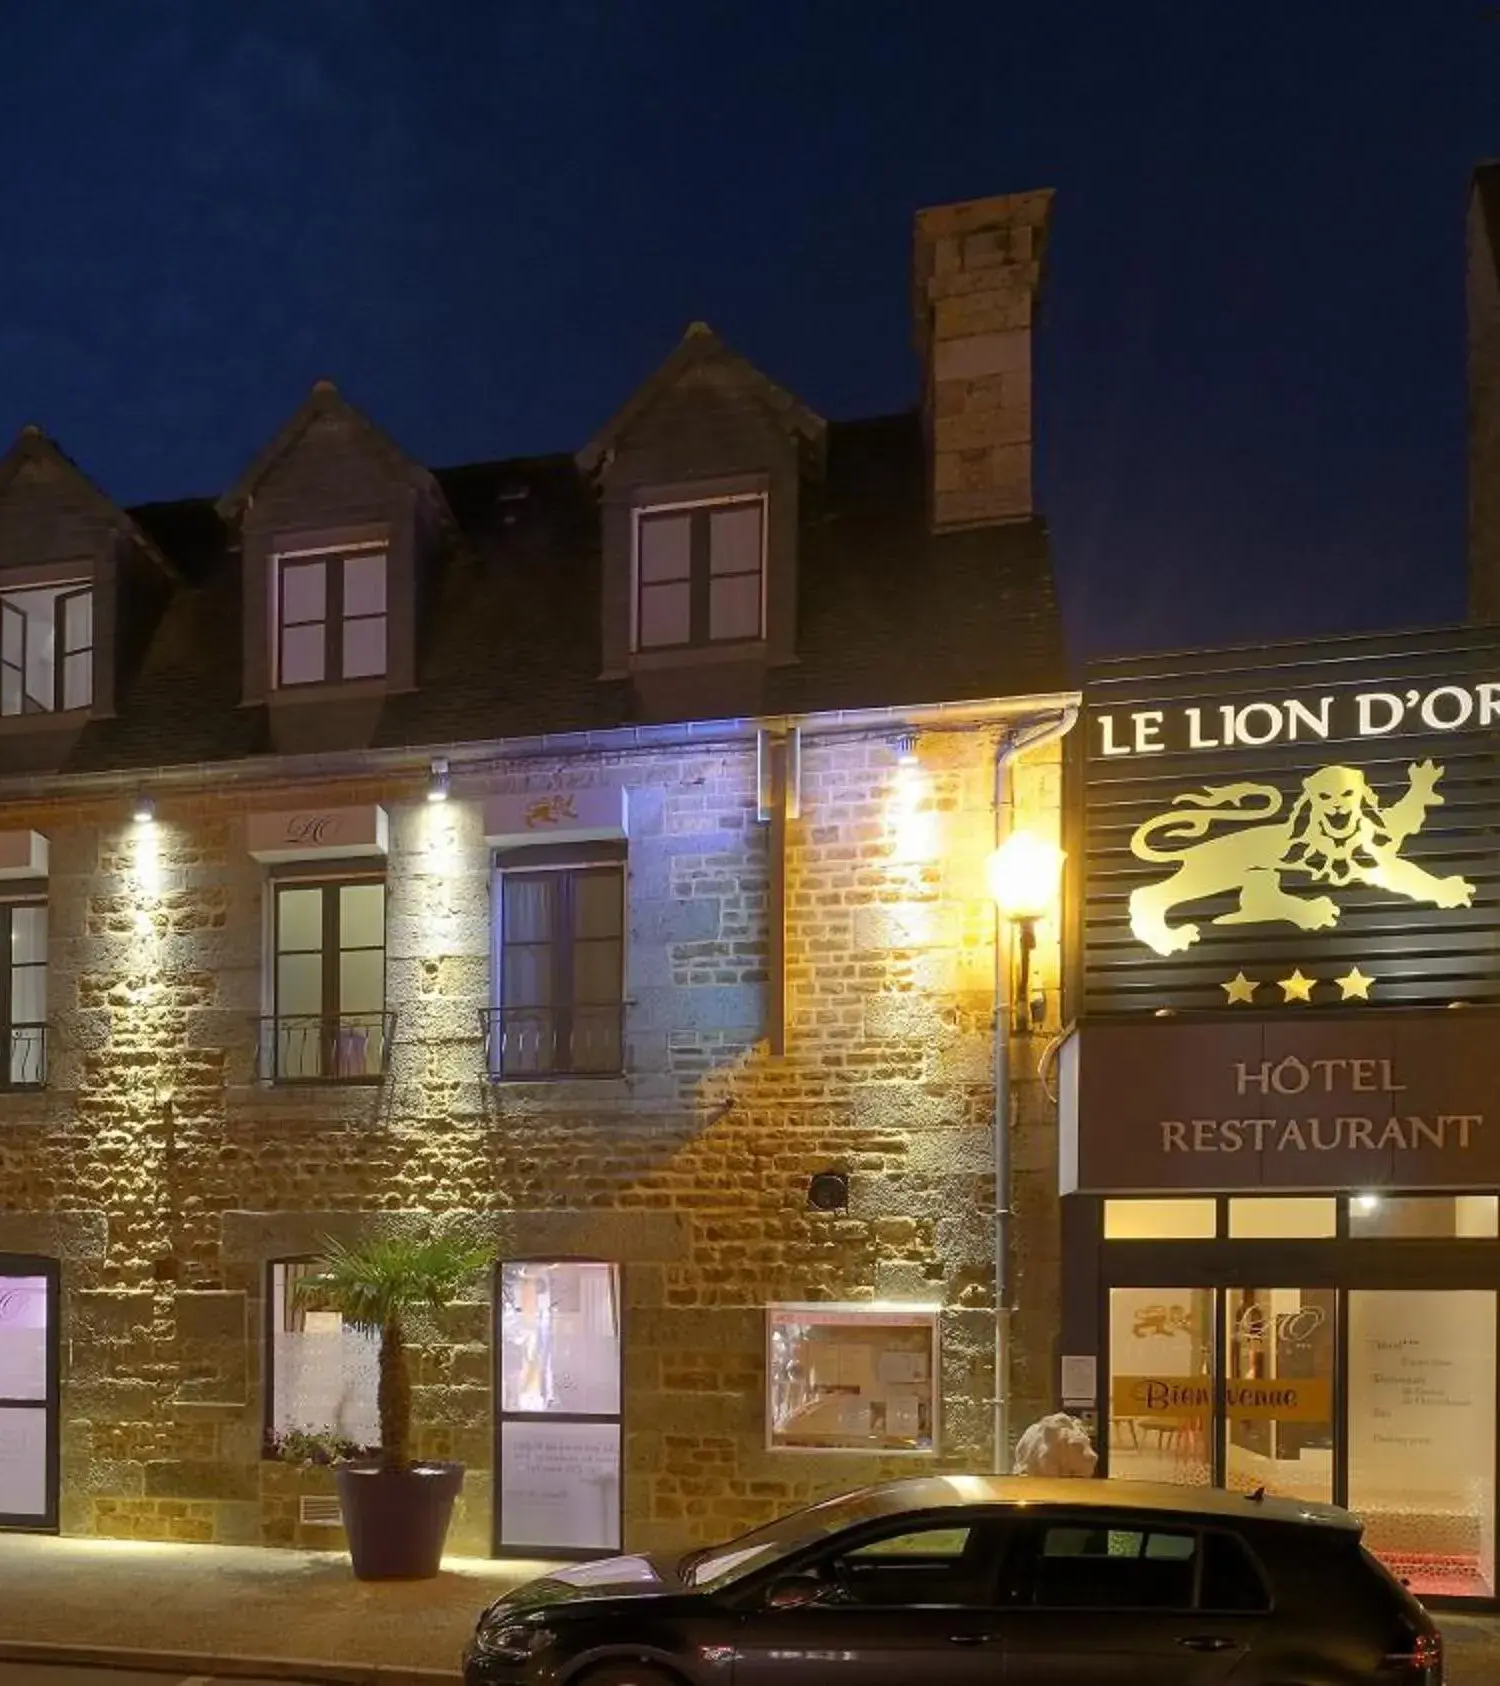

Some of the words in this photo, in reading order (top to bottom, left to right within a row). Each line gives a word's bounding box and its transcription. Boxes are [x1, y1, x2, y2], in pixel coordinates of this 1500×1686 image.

[1097, 711, 1165, 756] LE
[1184, 696, 1335, 749] LION
[1233, 1055, 1407, 1094] HÔTEL
[1159, 1114, 1483, 1152] RESTAURANT
[1132, 1378, 1298, 1410] Bienvenue
